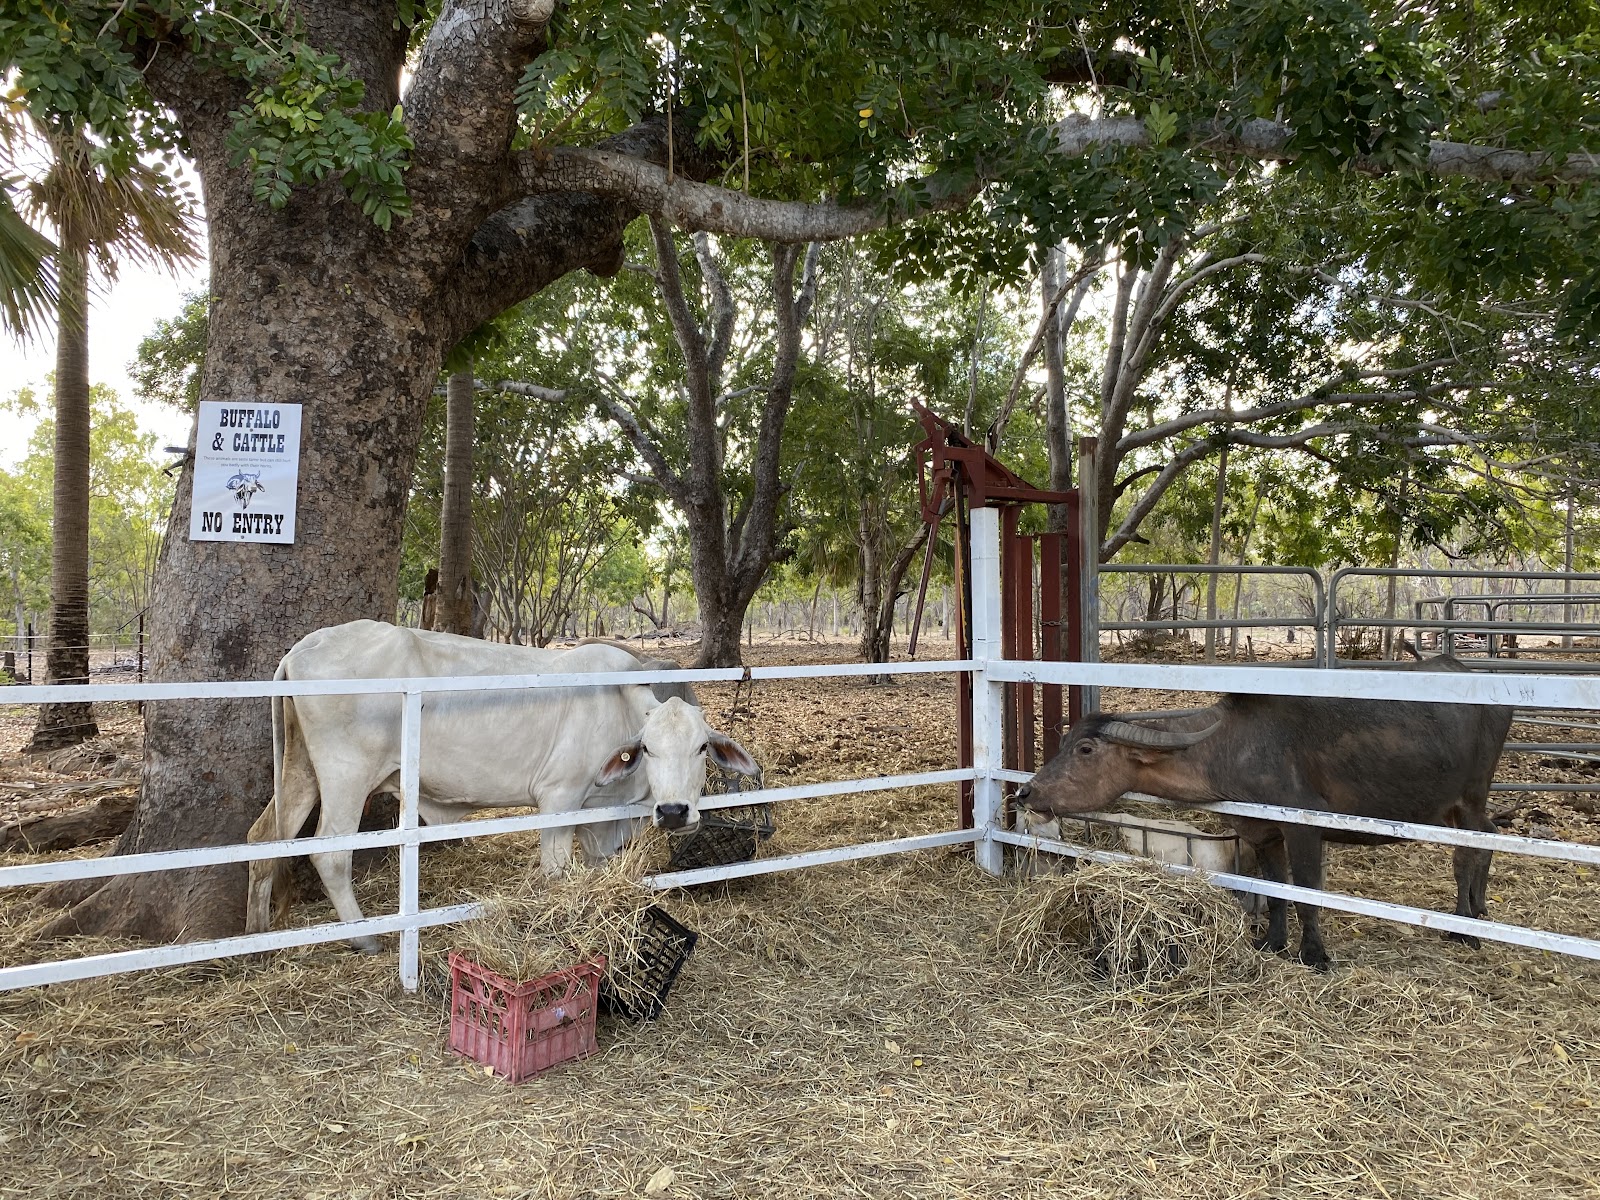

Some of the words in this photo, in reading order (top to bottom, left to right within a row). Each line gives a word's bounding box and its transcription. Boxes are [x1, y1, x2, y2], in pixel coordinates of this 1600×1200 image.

[219, 408, 281, 429] BUFFALO
[212, 432, 225, 451] &
[232, 432, 285, 453] CATTLE
[202, 511, 223, 533] NO
[232, 512, 284, 535] ENTRY
